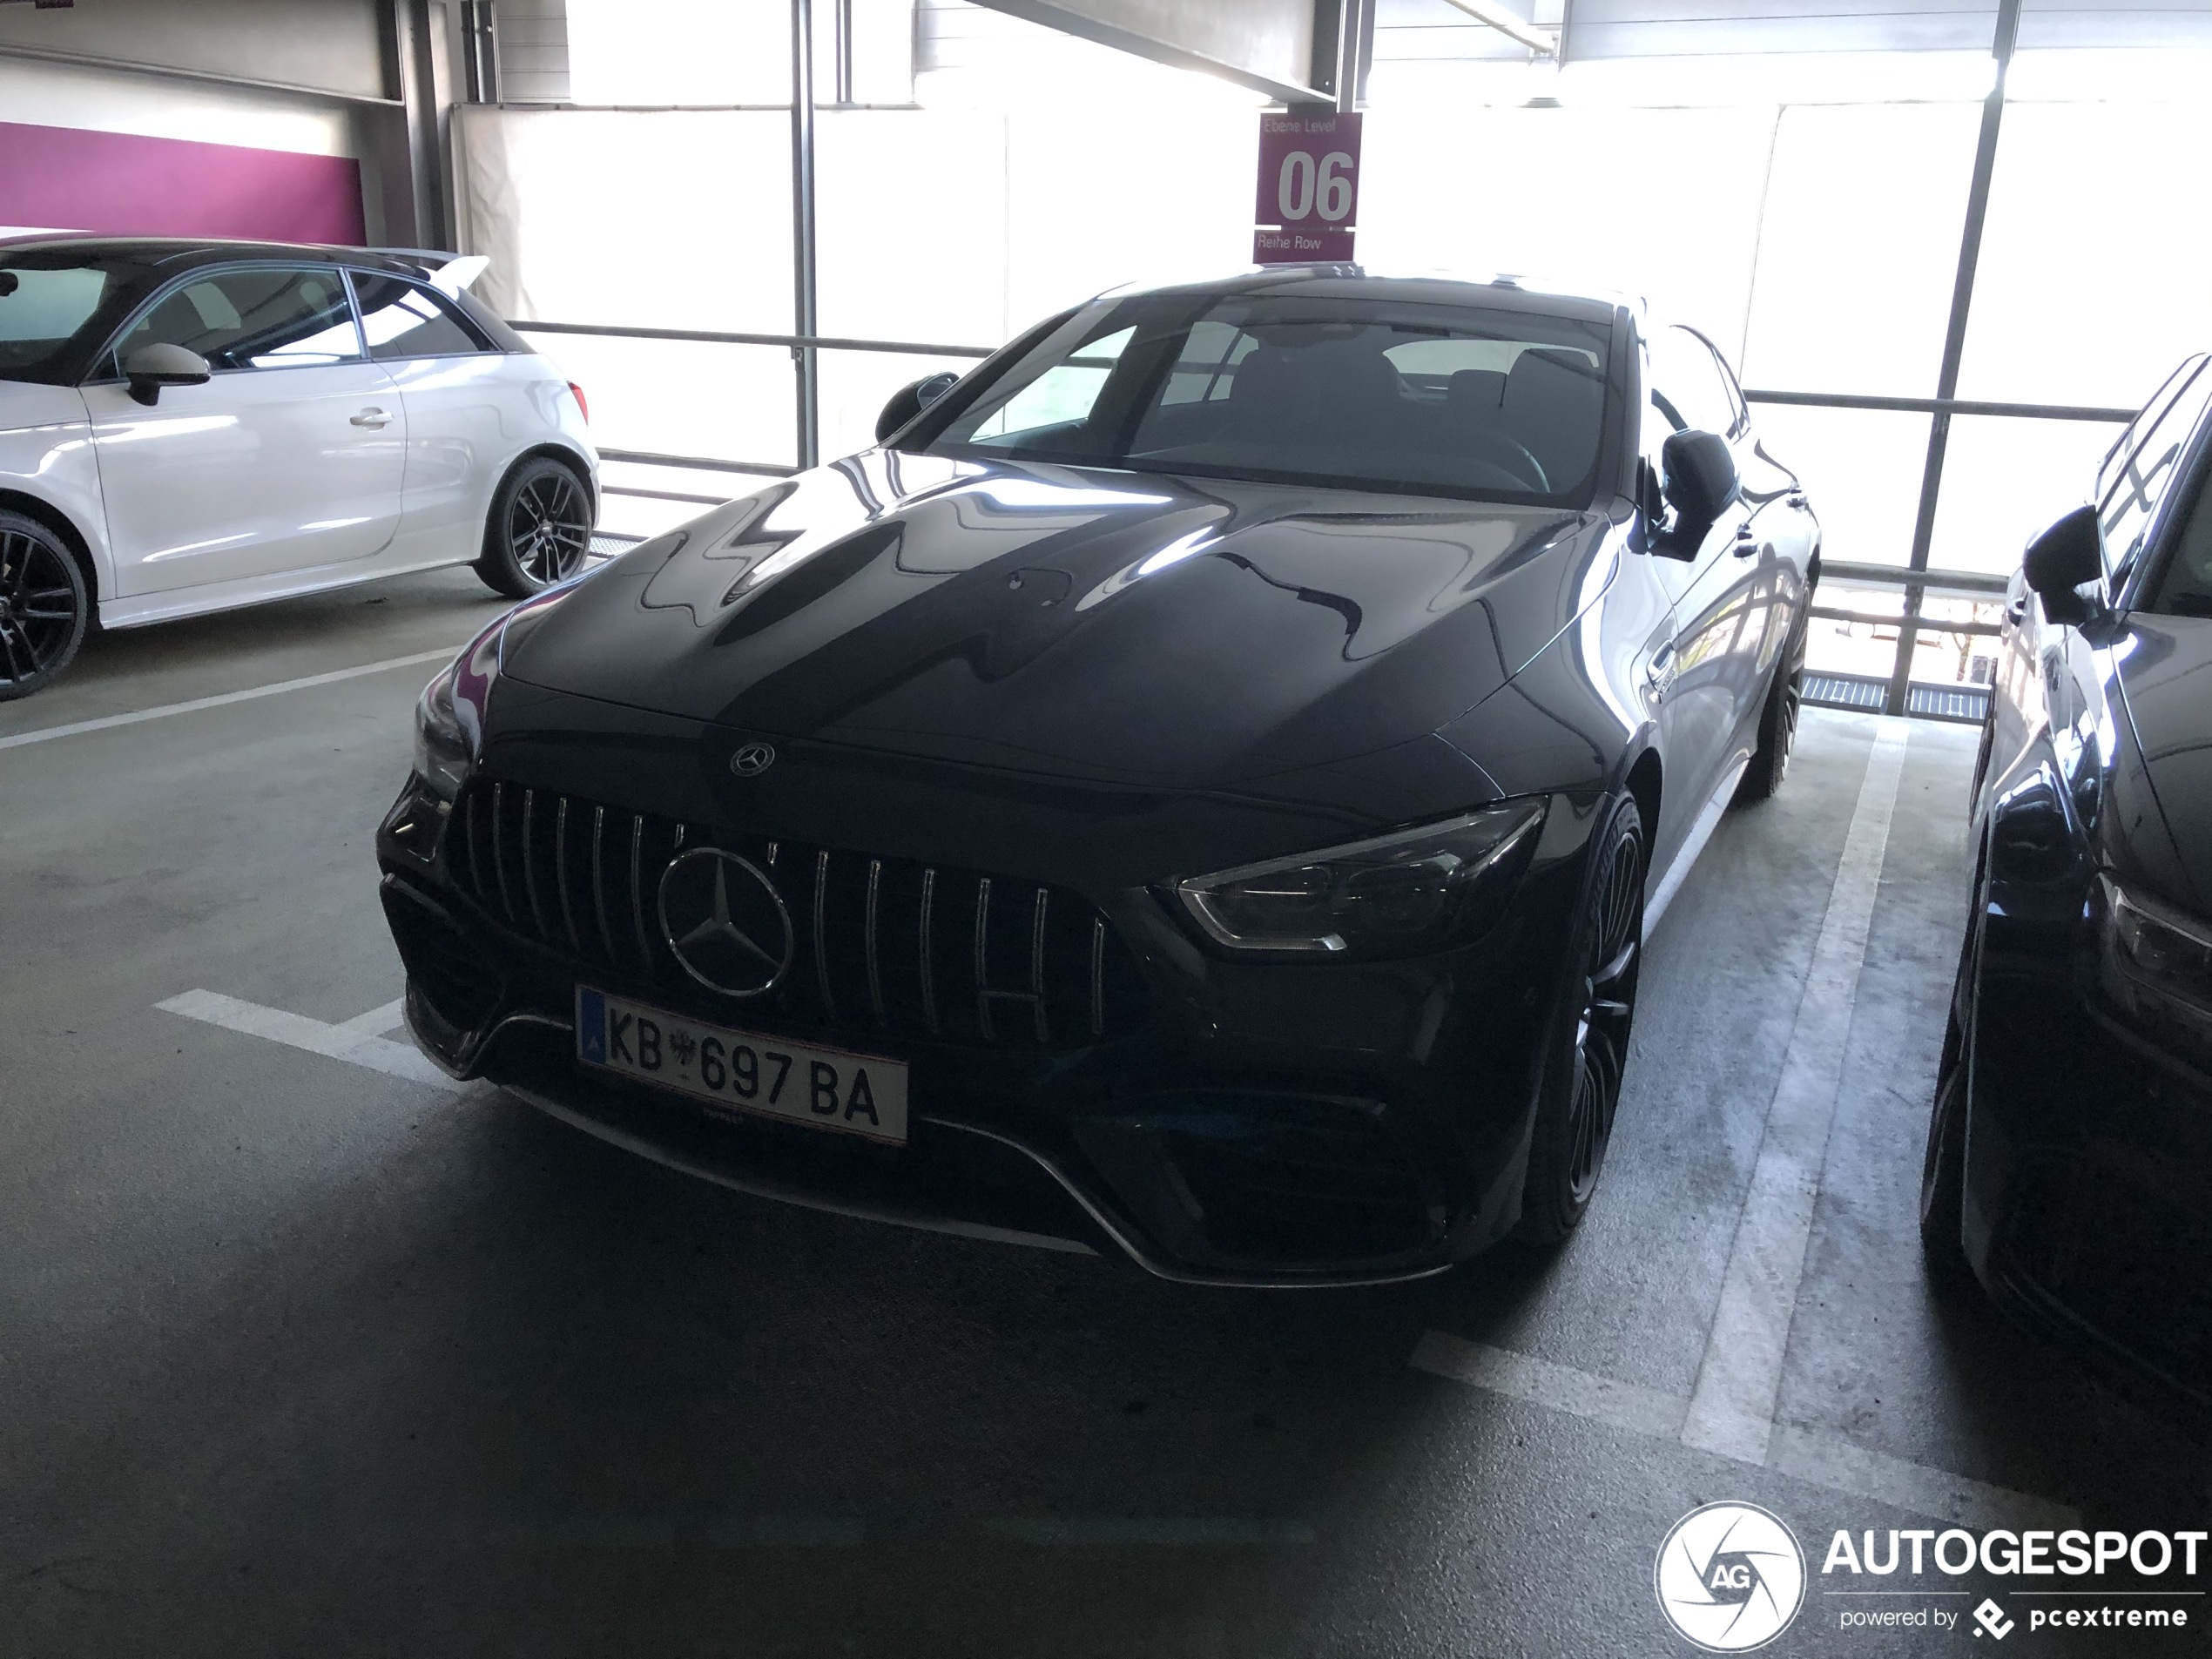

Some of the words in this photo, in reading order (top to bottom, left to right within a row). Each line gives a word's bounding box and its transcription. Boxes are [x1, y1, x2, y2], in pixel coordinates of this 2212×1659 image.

[1264, 118, 1301, 132] Ebene
[1305, 118, 1337, 132] Level
[1278, 151, 1354, 221] 06
[1258, 234, 1291, 248] Reihe
[1295, 235, 1321, 249] Row
[610, 1008, 662, 1071] KB
[700, 1036, 793, 1104] 697
[810, 1060, 880, 1127] BA
